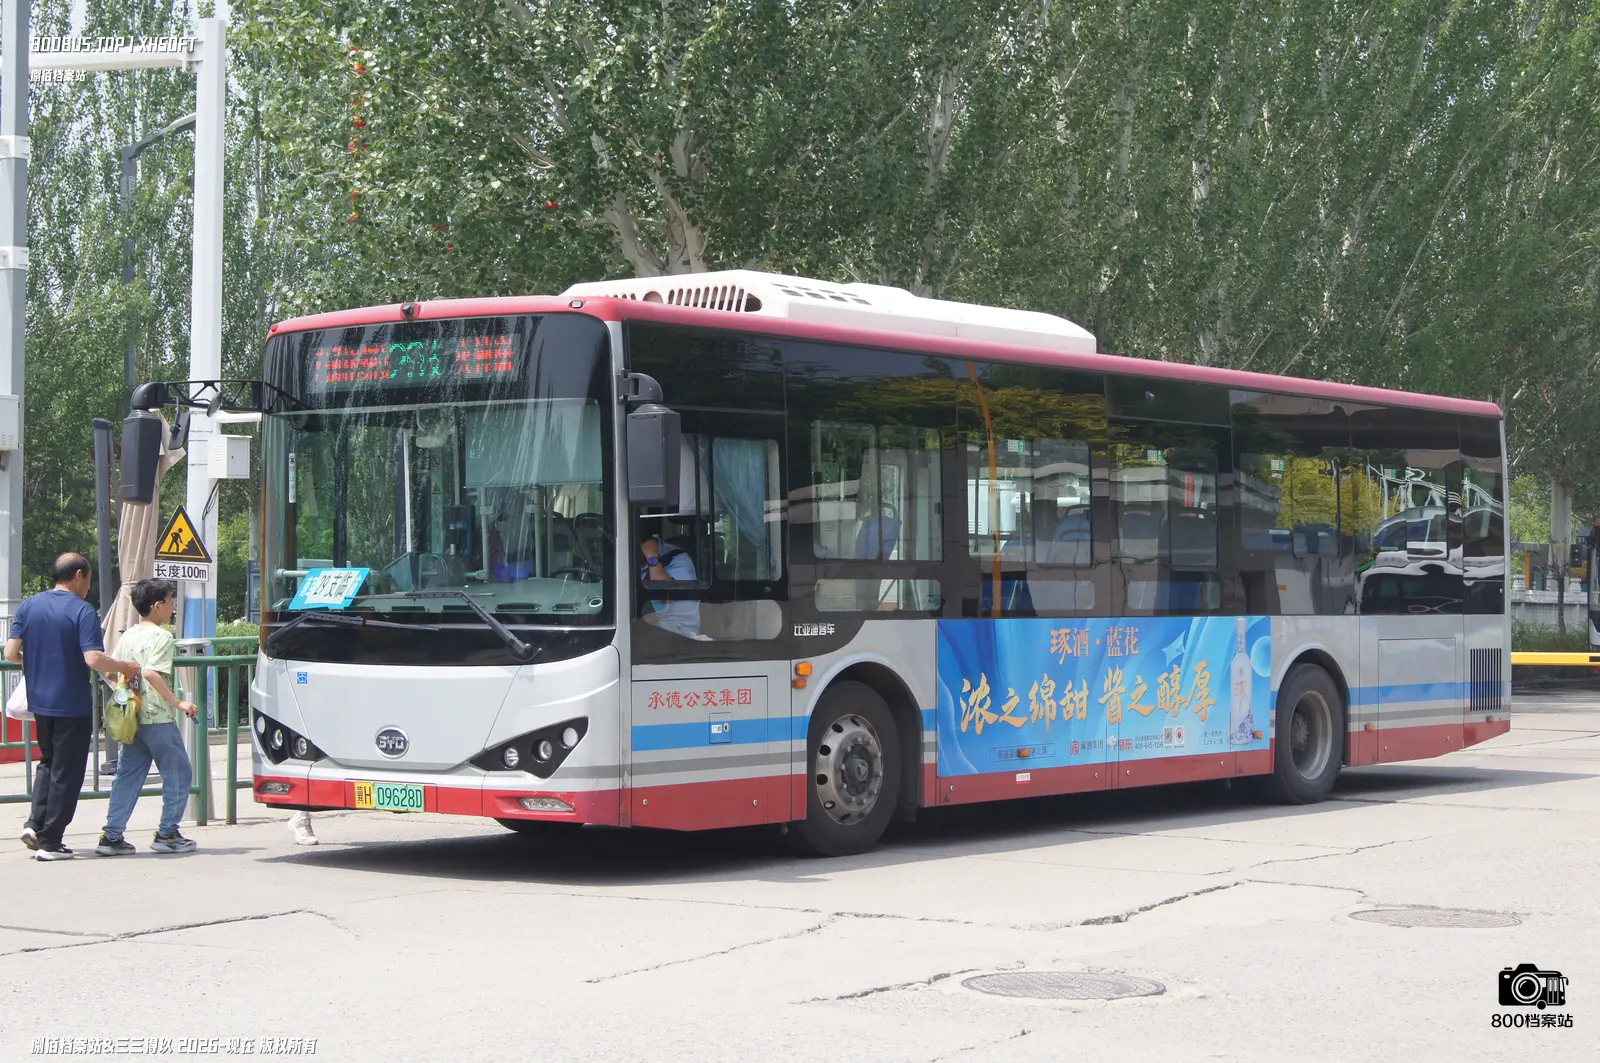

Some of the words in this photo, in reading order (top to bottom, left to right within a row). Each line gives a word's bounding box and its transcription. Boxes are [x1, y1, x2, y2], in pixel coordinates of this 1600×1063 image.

[155, 563, 207, 579] 长度100m
[793, 622, 835, 637] 比亚迪客车
[647, 687, 753, 710] 承德公交集团
[959, 671, 1090, 736] 浓之绵甜
[378, 735, 405, 750] BYD
